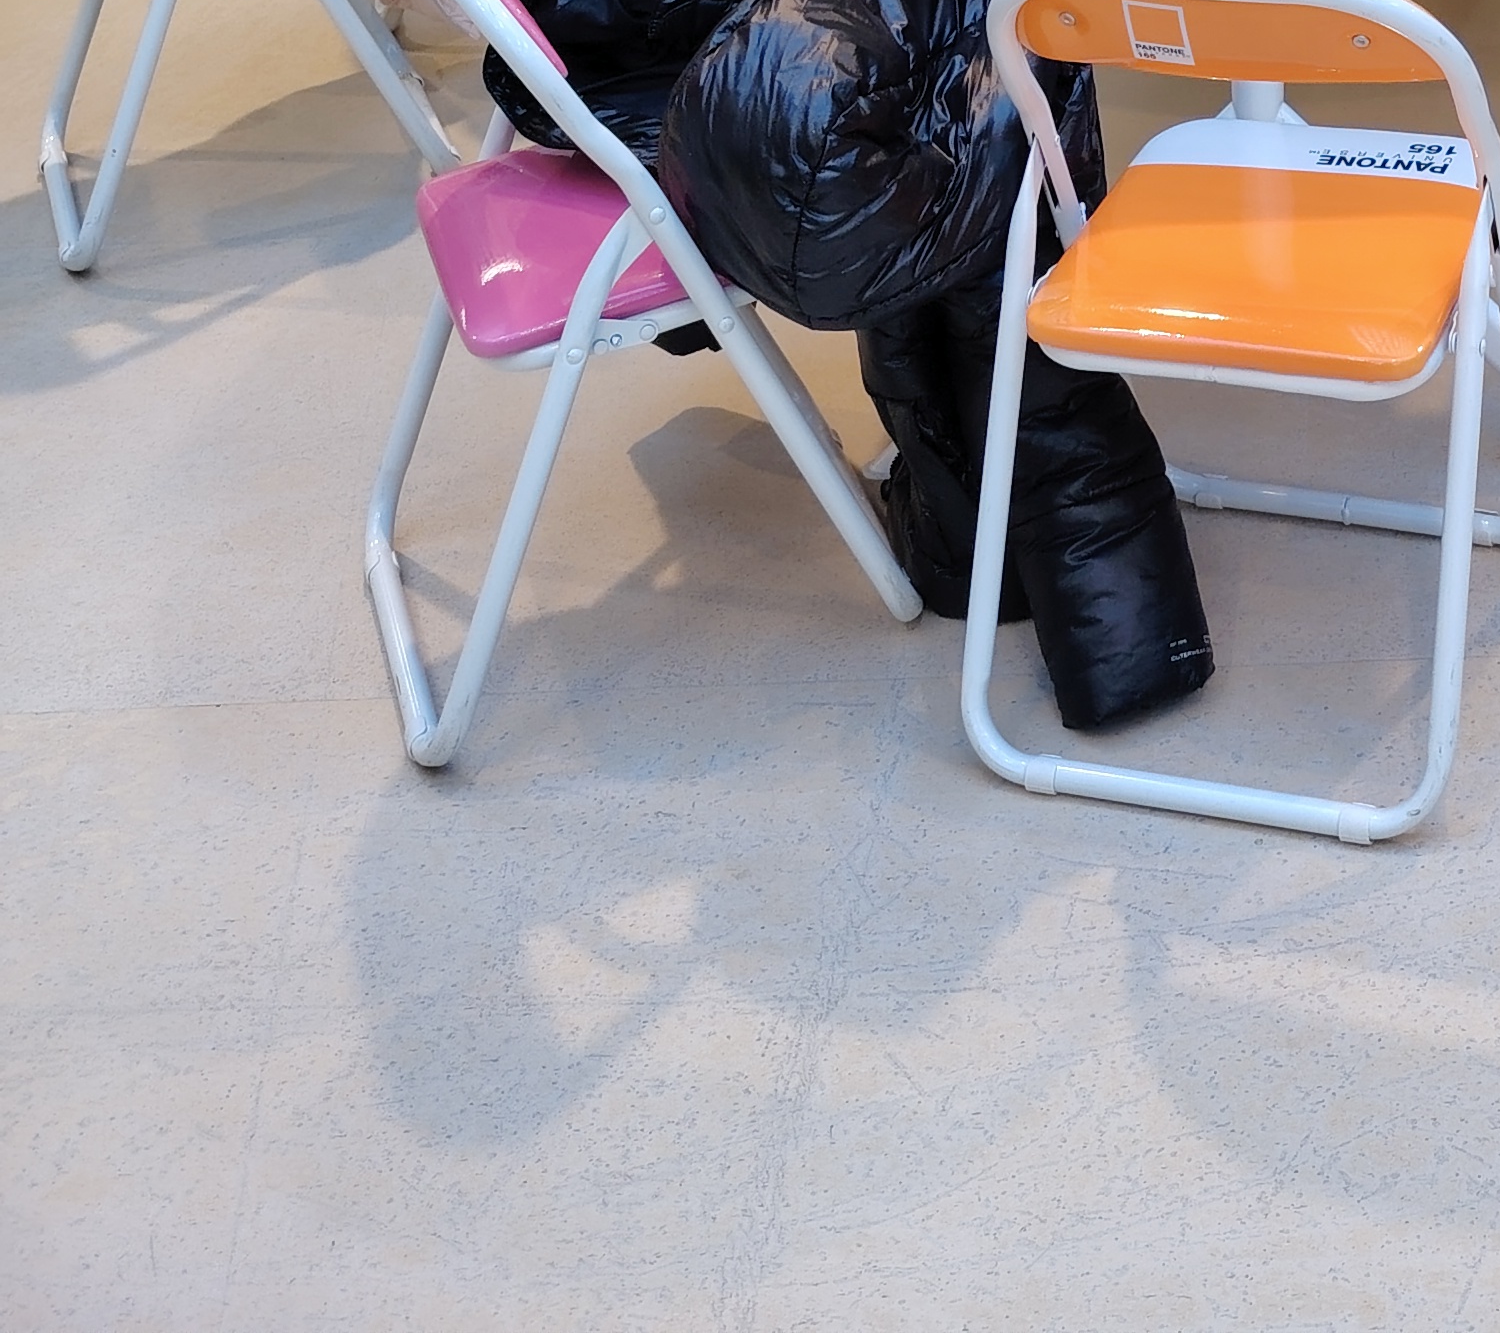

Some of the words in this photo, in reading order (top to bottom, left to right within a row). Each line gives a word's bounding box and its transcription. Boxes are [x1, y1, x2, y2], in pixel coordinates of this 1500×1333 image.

[1135, 42, 1185, 56] PANTONE
[1409, 144, 1457, 156] 165
[1316, 154, 1450, 175] PANTONE
